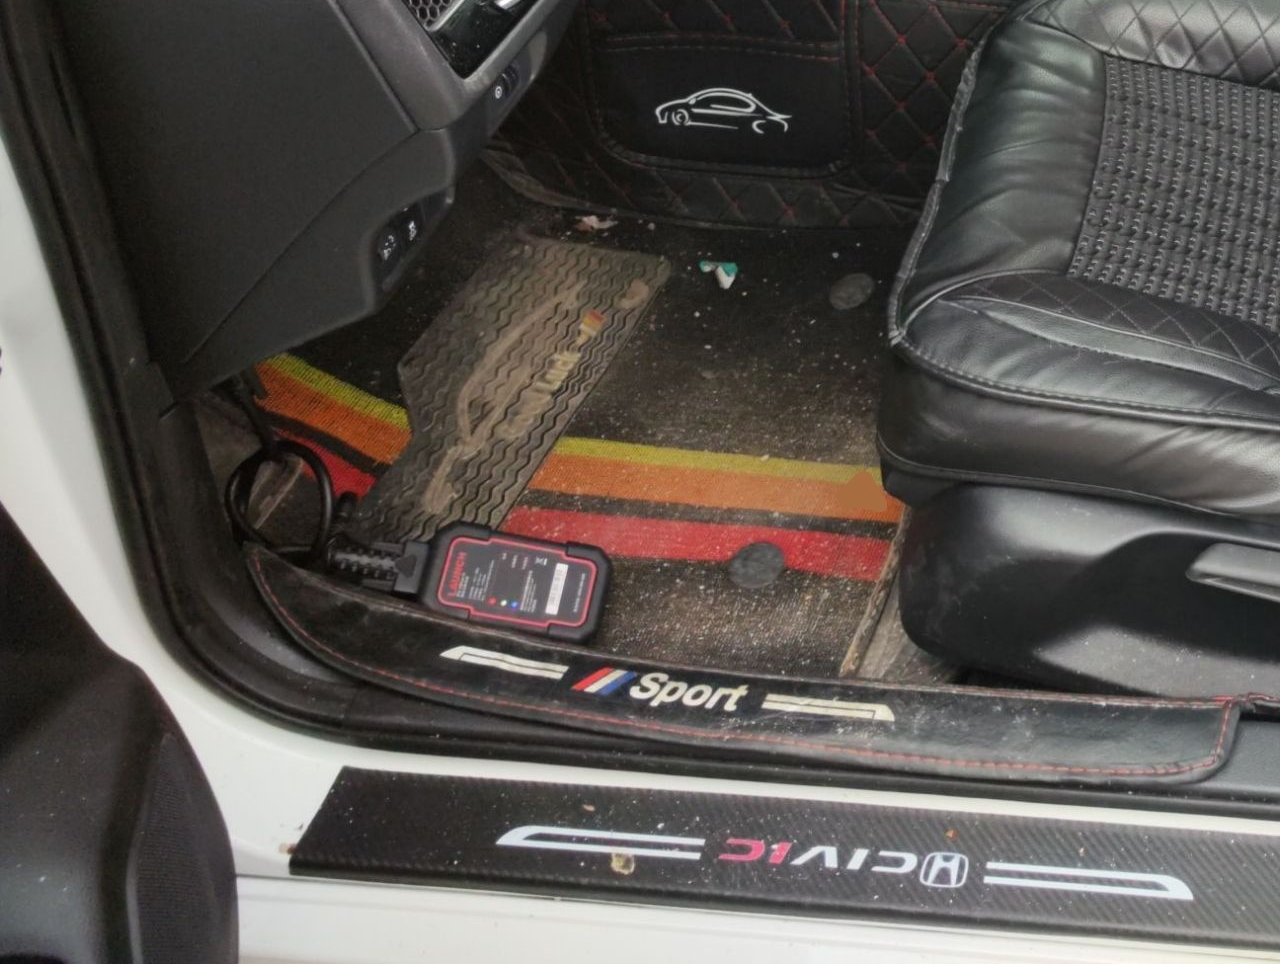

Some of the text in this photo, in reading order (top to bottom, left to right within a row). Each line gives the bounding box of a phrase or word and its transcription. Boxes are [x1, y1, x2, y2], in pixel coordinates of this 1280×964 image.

[447, 550, 468, 599] LAUNCH
[629, 672, 750, 712] Sport
[718, 837, 919, 875] CIVIC
